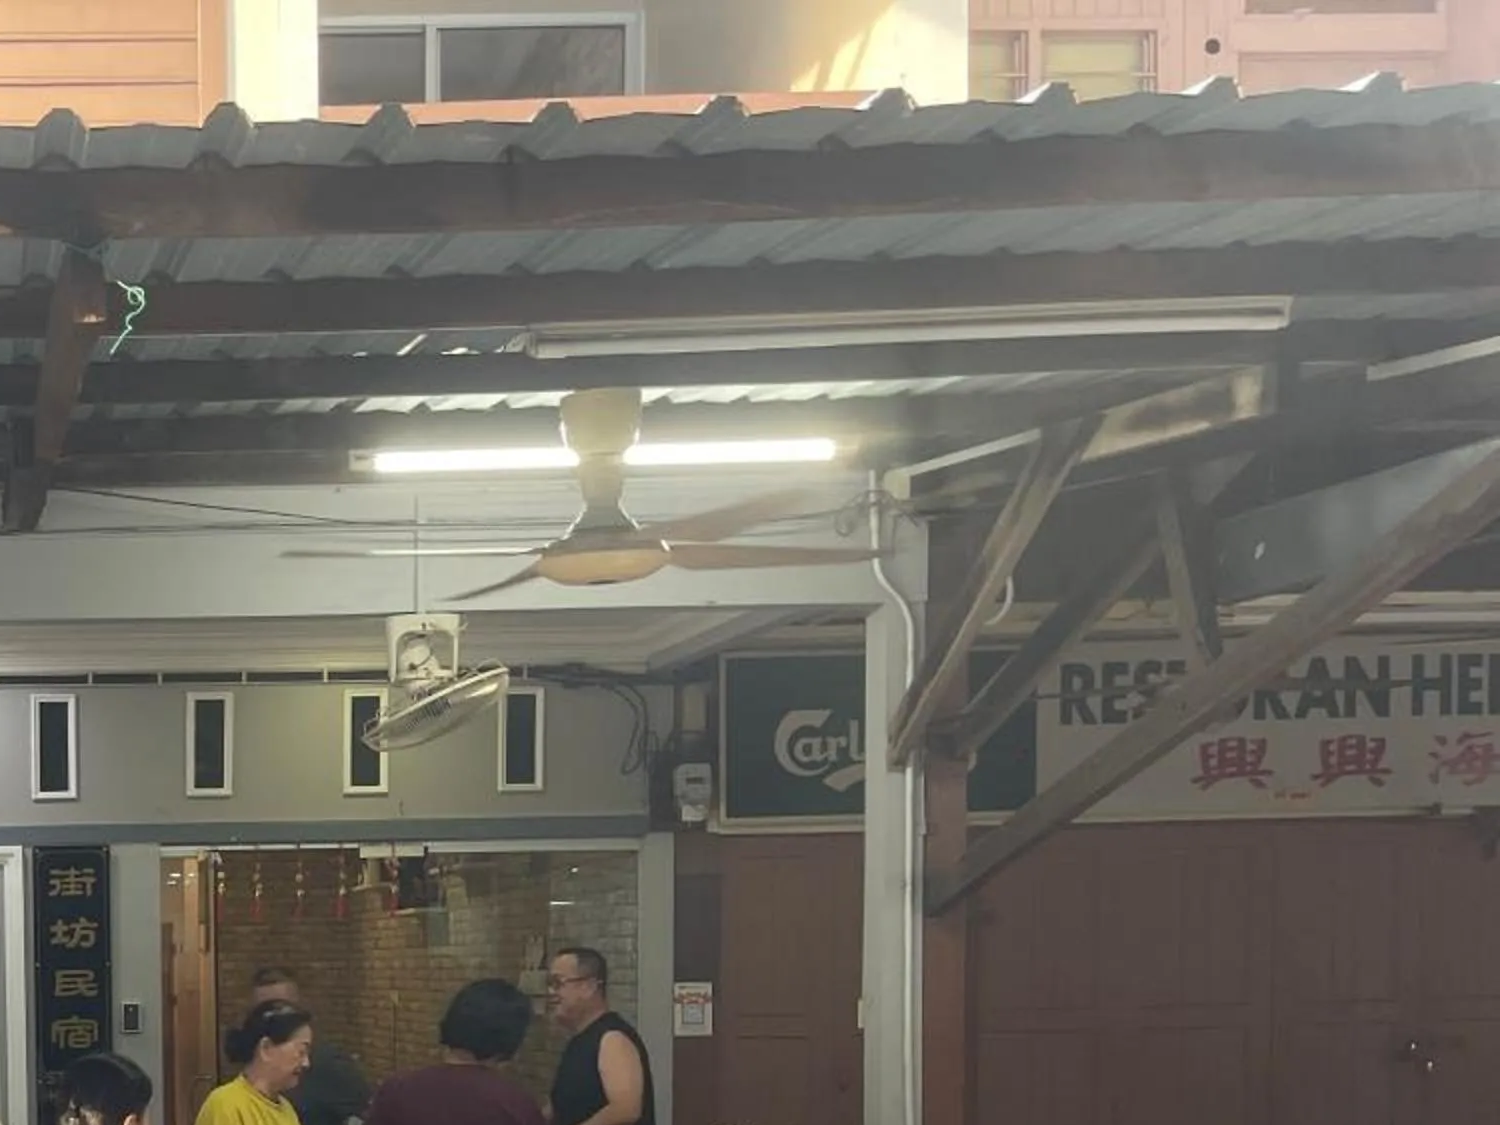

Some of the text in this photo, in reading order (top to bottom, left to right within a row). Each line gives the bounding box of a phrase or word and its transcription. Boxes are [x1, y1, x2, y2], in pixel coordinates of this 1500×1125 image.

[1059, 655, 1390, 726] RESRAN
[774, 709, 866, 777] Carl
[49, 867, 99, 1050] 街坊民宿
